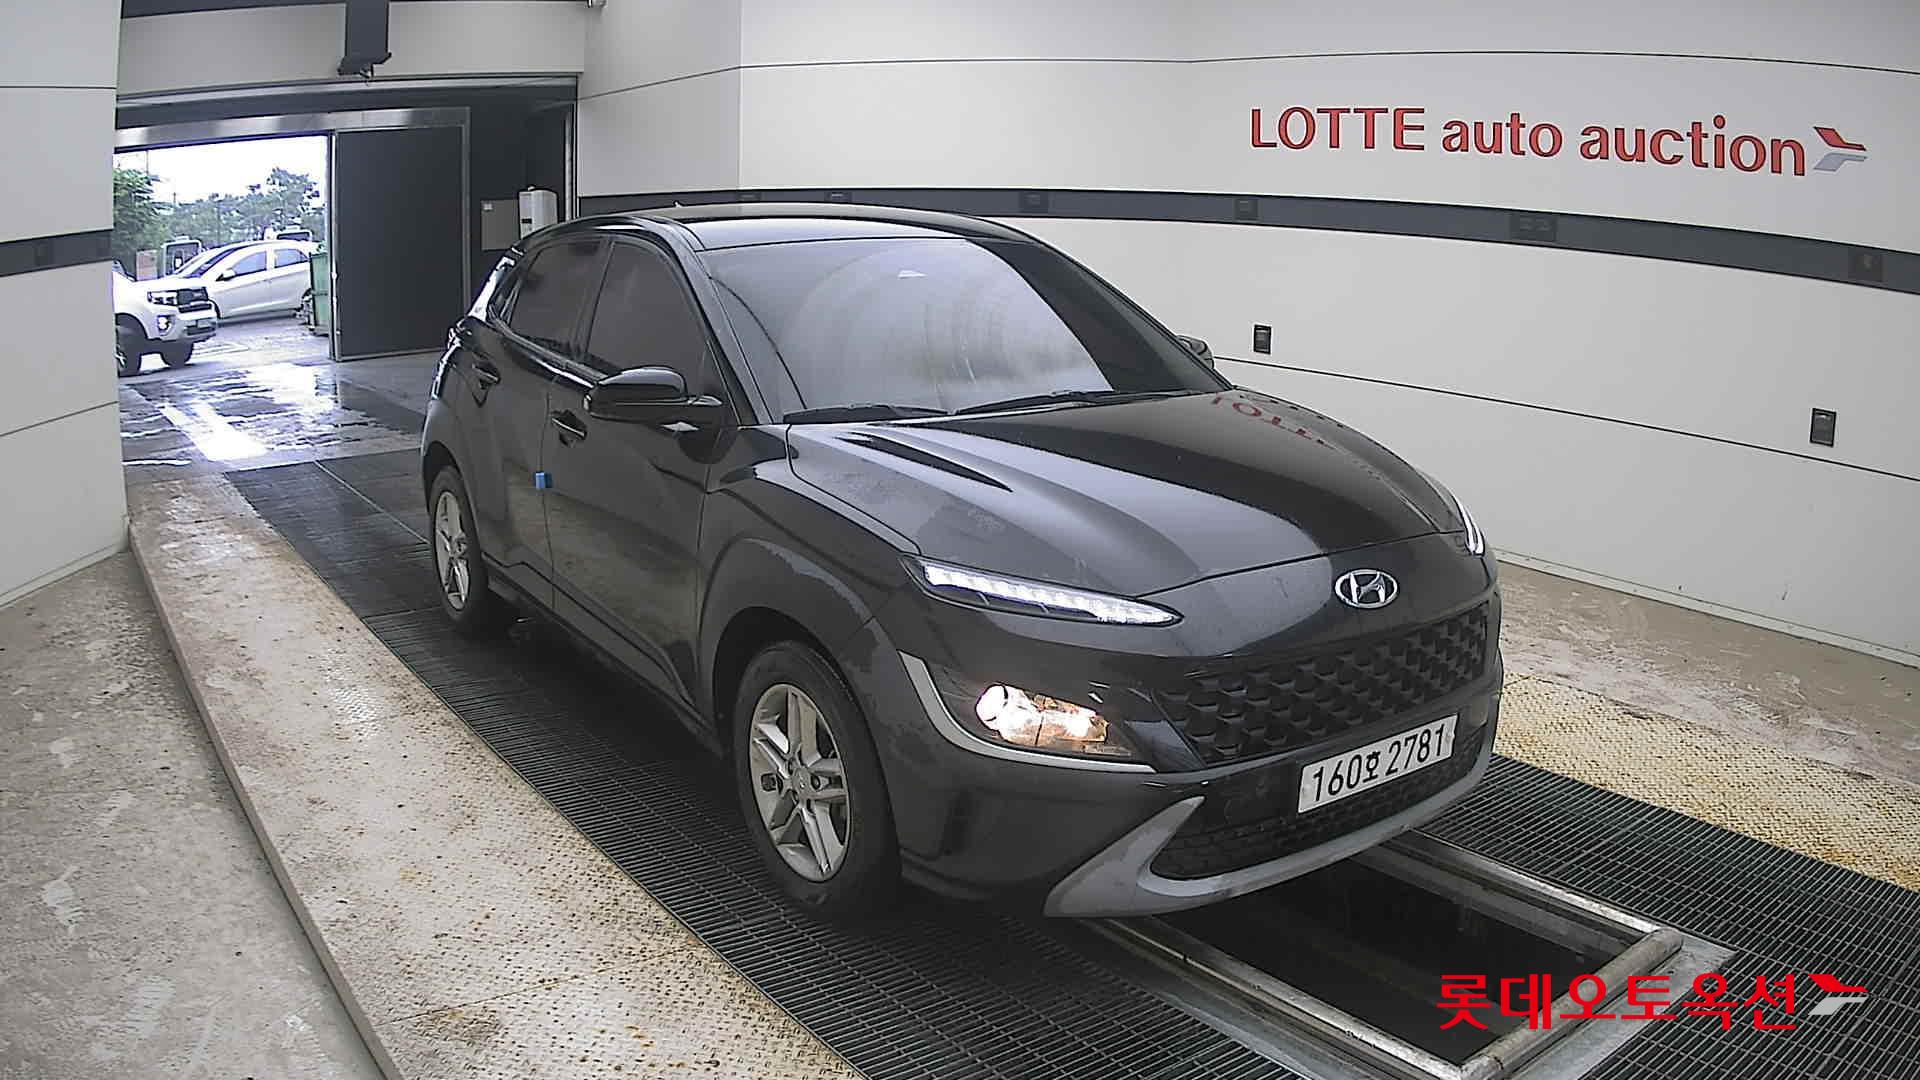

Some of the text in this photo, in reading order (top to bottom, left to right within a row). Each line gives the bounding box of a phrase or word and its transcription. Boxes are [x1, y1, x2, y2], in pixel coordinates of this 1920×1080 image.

[1250, 106, 1806, 176] LOTTE auto auction
[1385, 723, 1445, 776] 2781
